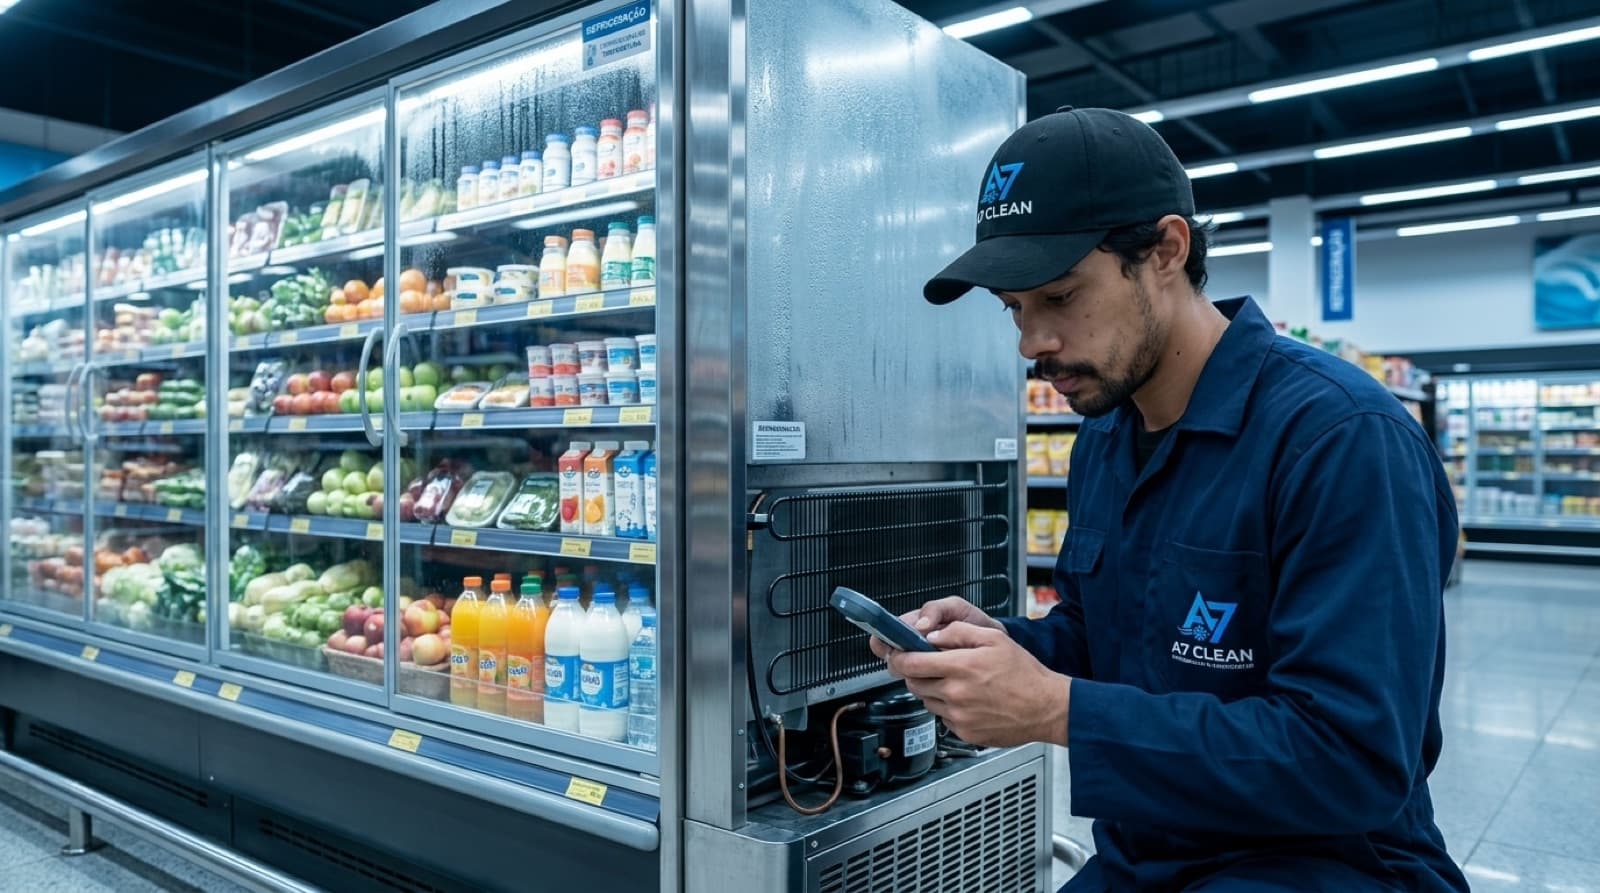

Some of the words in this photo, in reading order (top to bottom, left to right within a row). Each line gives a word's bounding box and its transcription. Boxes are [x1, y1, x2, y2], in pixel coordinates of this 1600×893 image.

[985, 200, 1032, 220] CLEAN
[1171, 641, 1190, 656] A7
[1192, 645, 1253, 663] CLEAN
